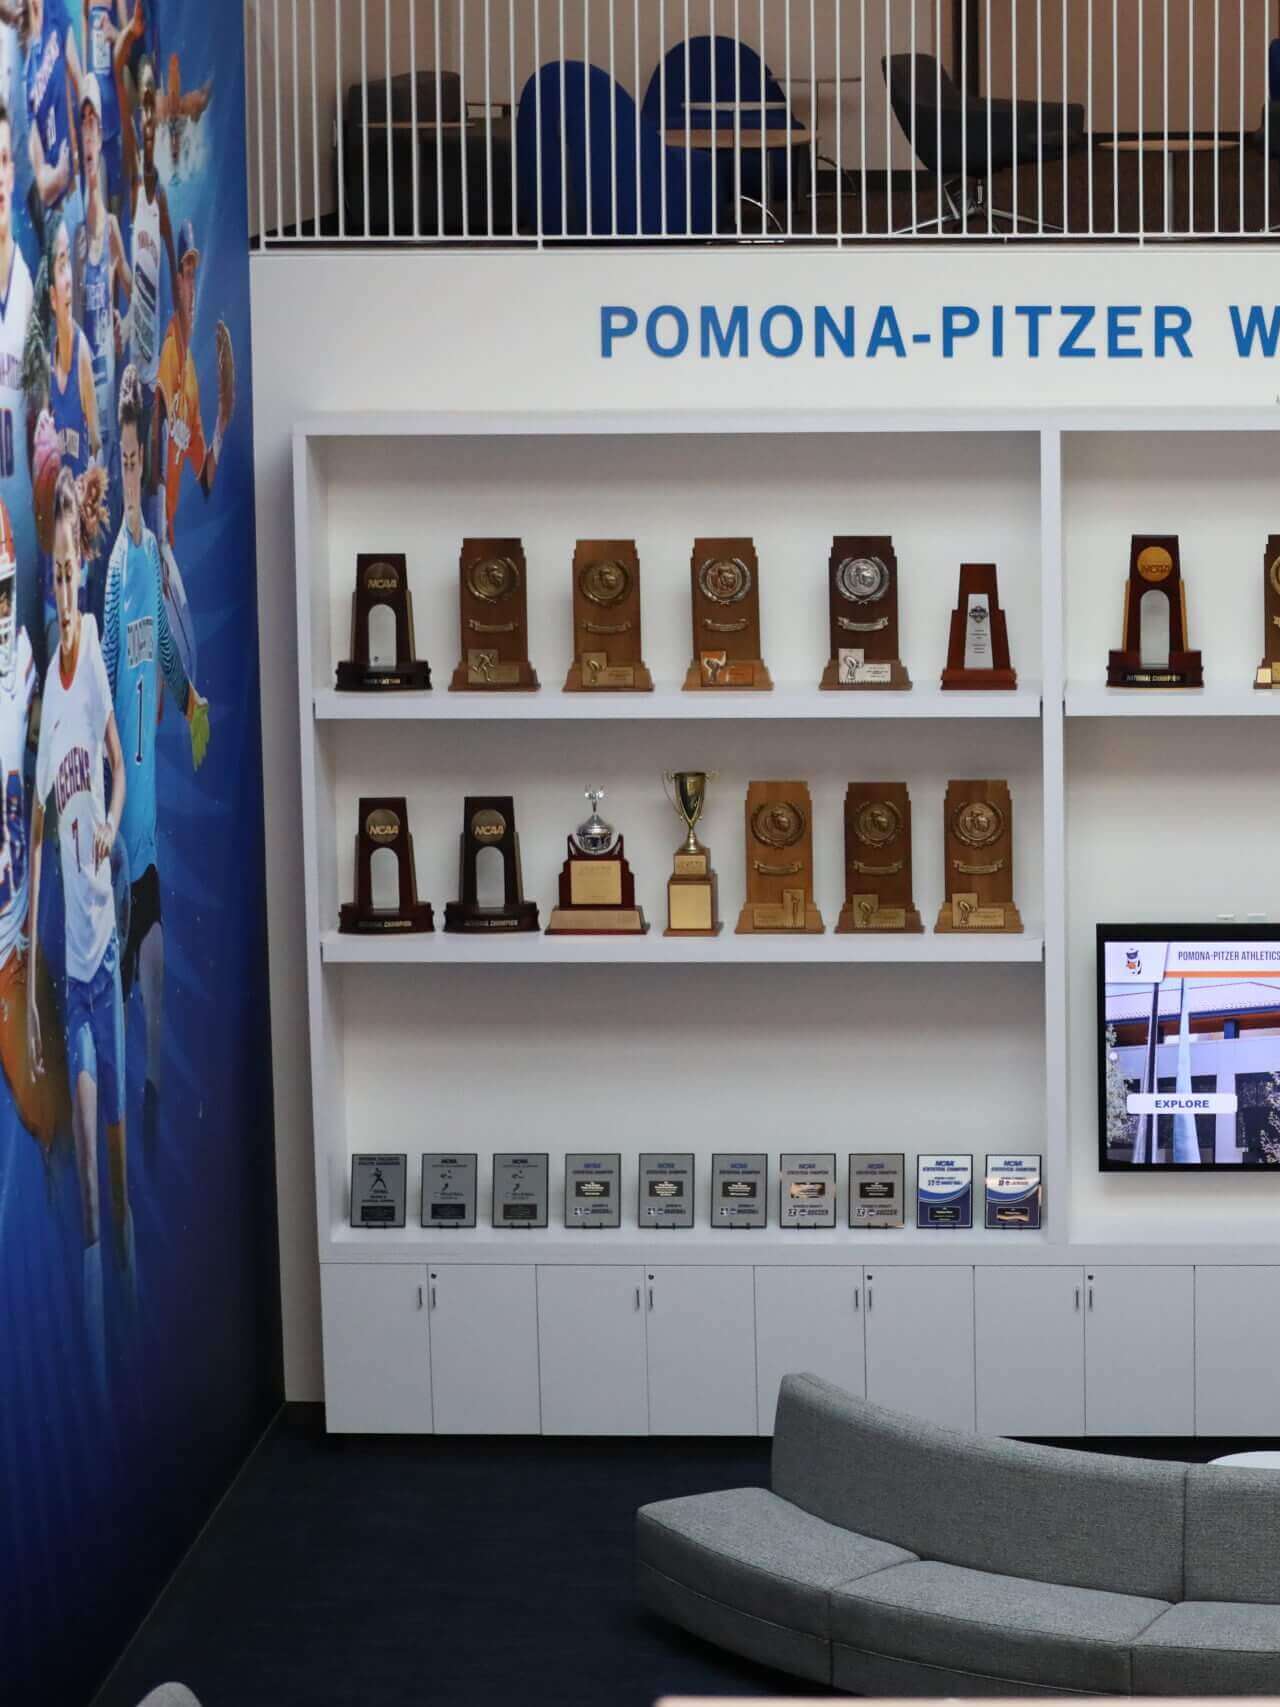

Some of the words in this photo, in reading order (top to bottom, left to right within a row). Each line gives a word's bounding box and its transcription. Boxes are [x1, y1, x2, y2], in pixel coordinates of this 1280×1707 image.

[601, 305, 1194, 359] POMONA-PITZER
[369, 825, 399, 835] NCAA
[474, 825, 504, 835] NCAA
[1178, 951, 1239, 961] POMONA-PITZER
[1241, 951, 1280, 961] ATHLETICS
[1155, 1100, 1209, 1109] EXPLORE
